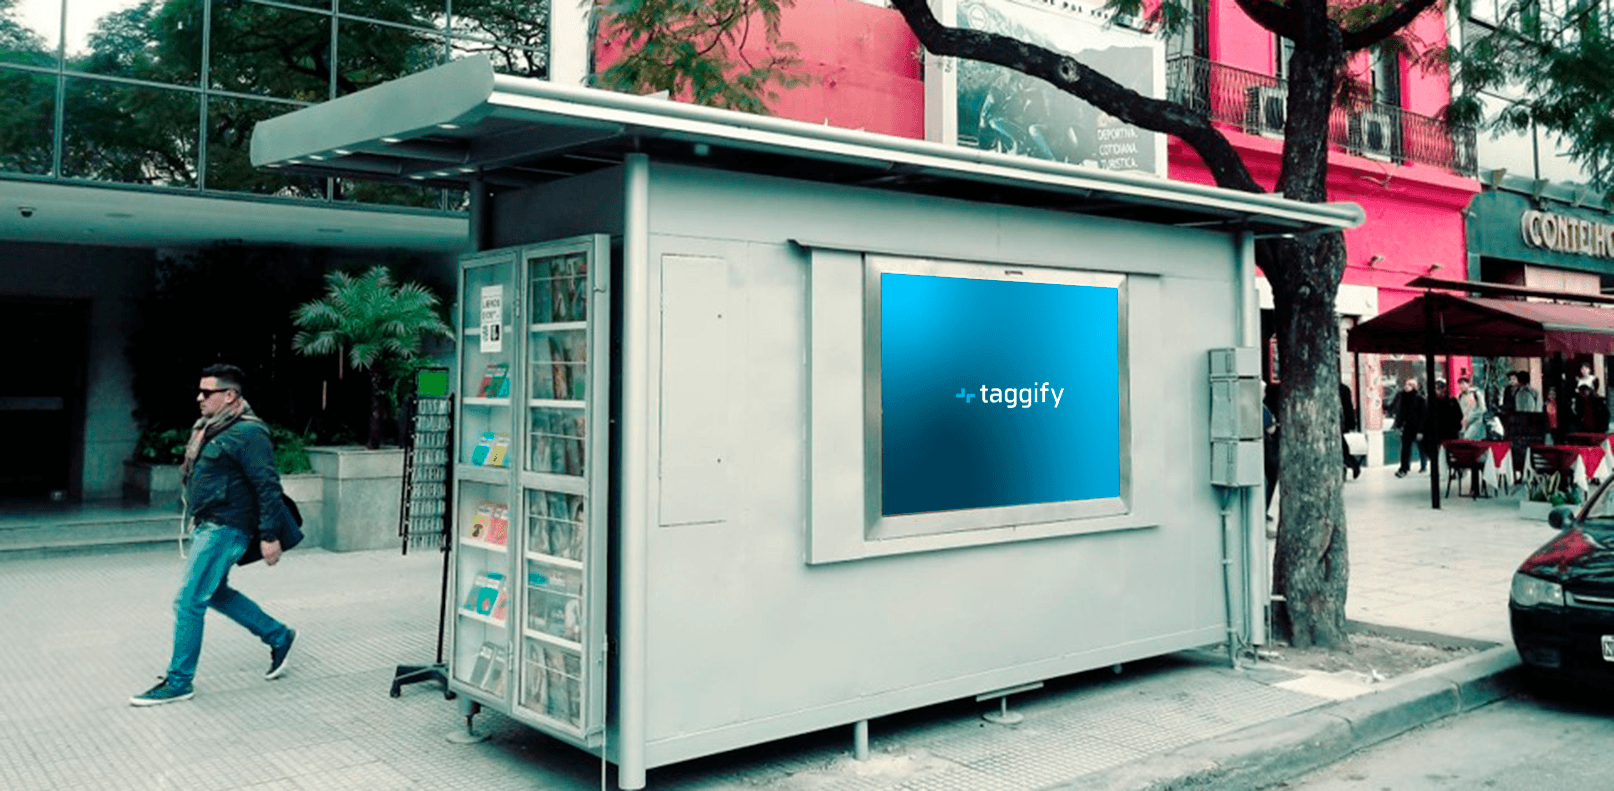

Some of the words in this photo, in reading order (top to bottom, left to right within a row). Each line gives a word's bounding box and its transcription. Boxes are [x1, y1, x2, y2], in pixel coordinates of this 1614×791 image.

[1097, 128, 1138, 140] DEPORTIVA.
[1099, 143, 1139, 156] COTIDIANA.
[980, 381, 1064, 408] taggify
